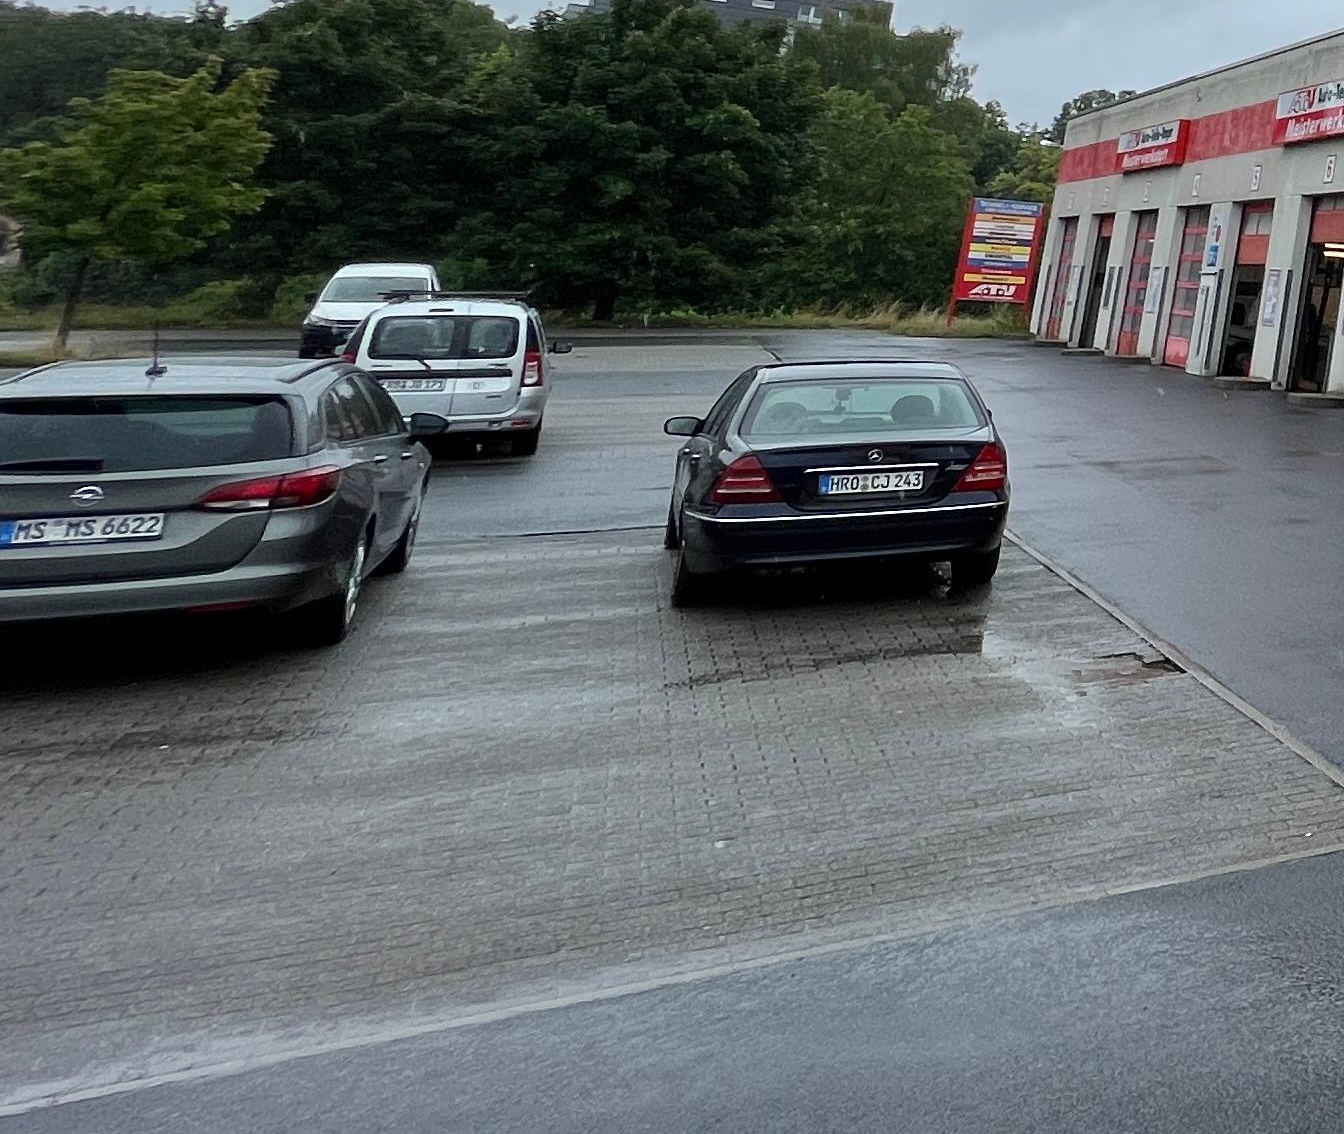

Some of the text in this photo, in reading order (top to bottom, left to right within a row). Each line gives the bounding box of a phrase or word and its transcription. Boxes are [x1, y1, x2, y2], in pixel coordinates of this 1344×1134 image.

[830, 473, 921, 492] HRO CJ 243
[14, 516, 160, 540] MS MS 6622
